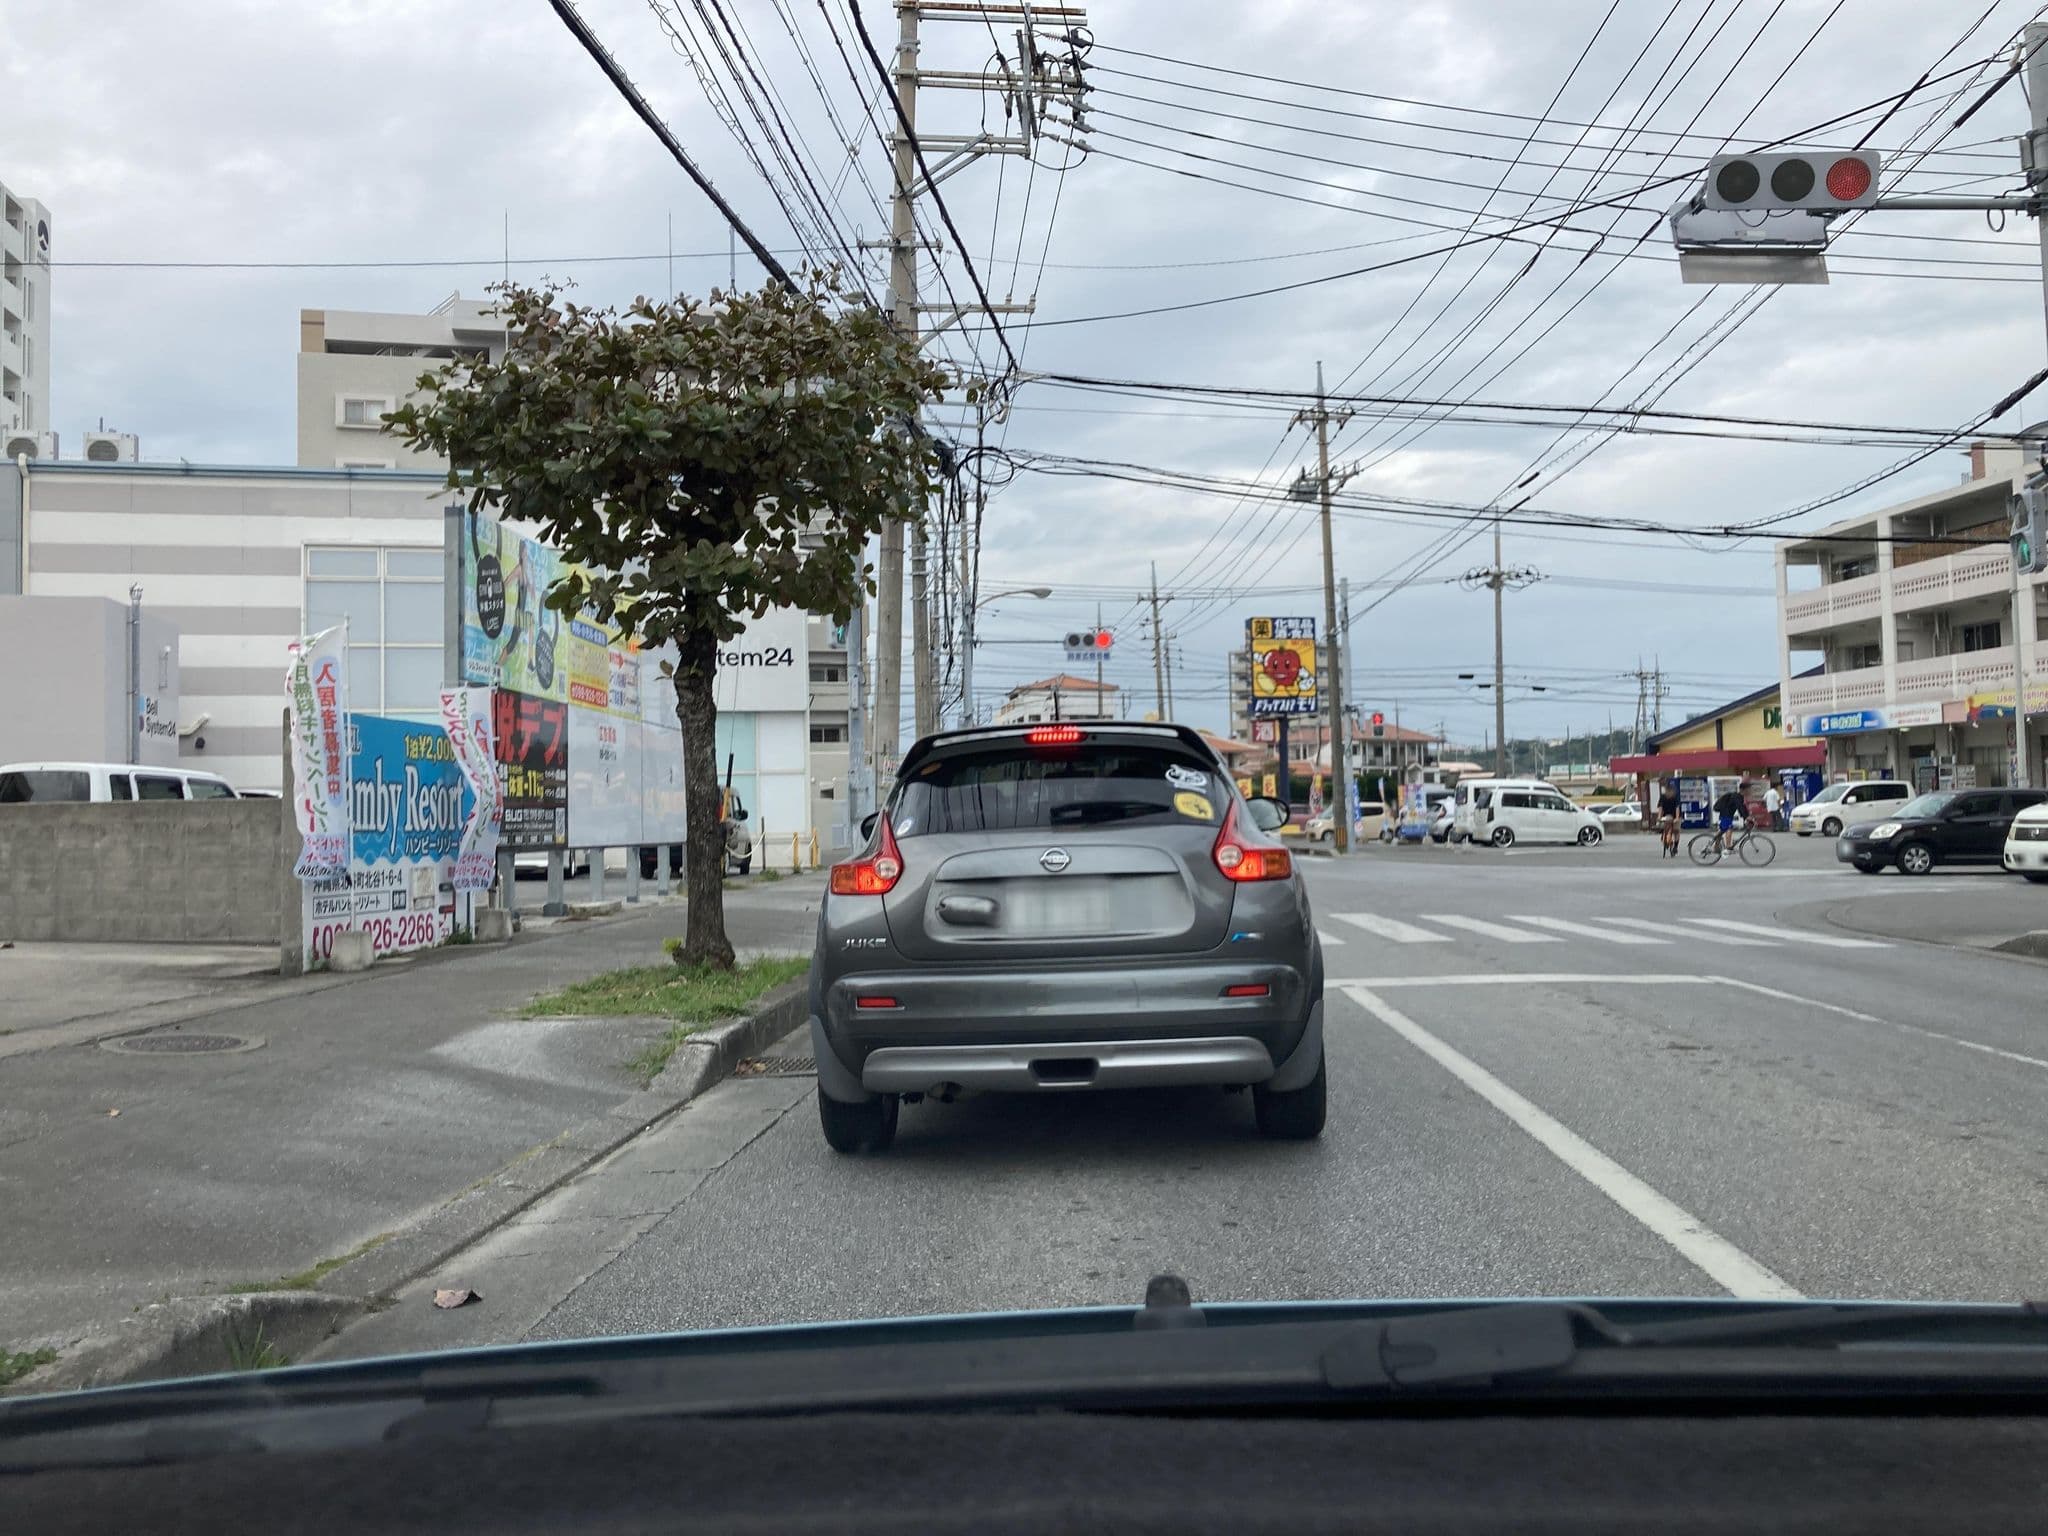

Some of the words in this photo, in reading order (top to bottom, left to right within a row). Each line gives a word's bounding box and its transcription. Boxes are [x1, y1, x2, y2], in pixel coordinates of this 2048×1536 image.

[716, 647, 794, 667] tem24
[404, 764, 464, 832] Resort
[312, 868, 403, 893] 沖縄県北町北谷1-6-4
[841, 937, 888, 951] JUKE
